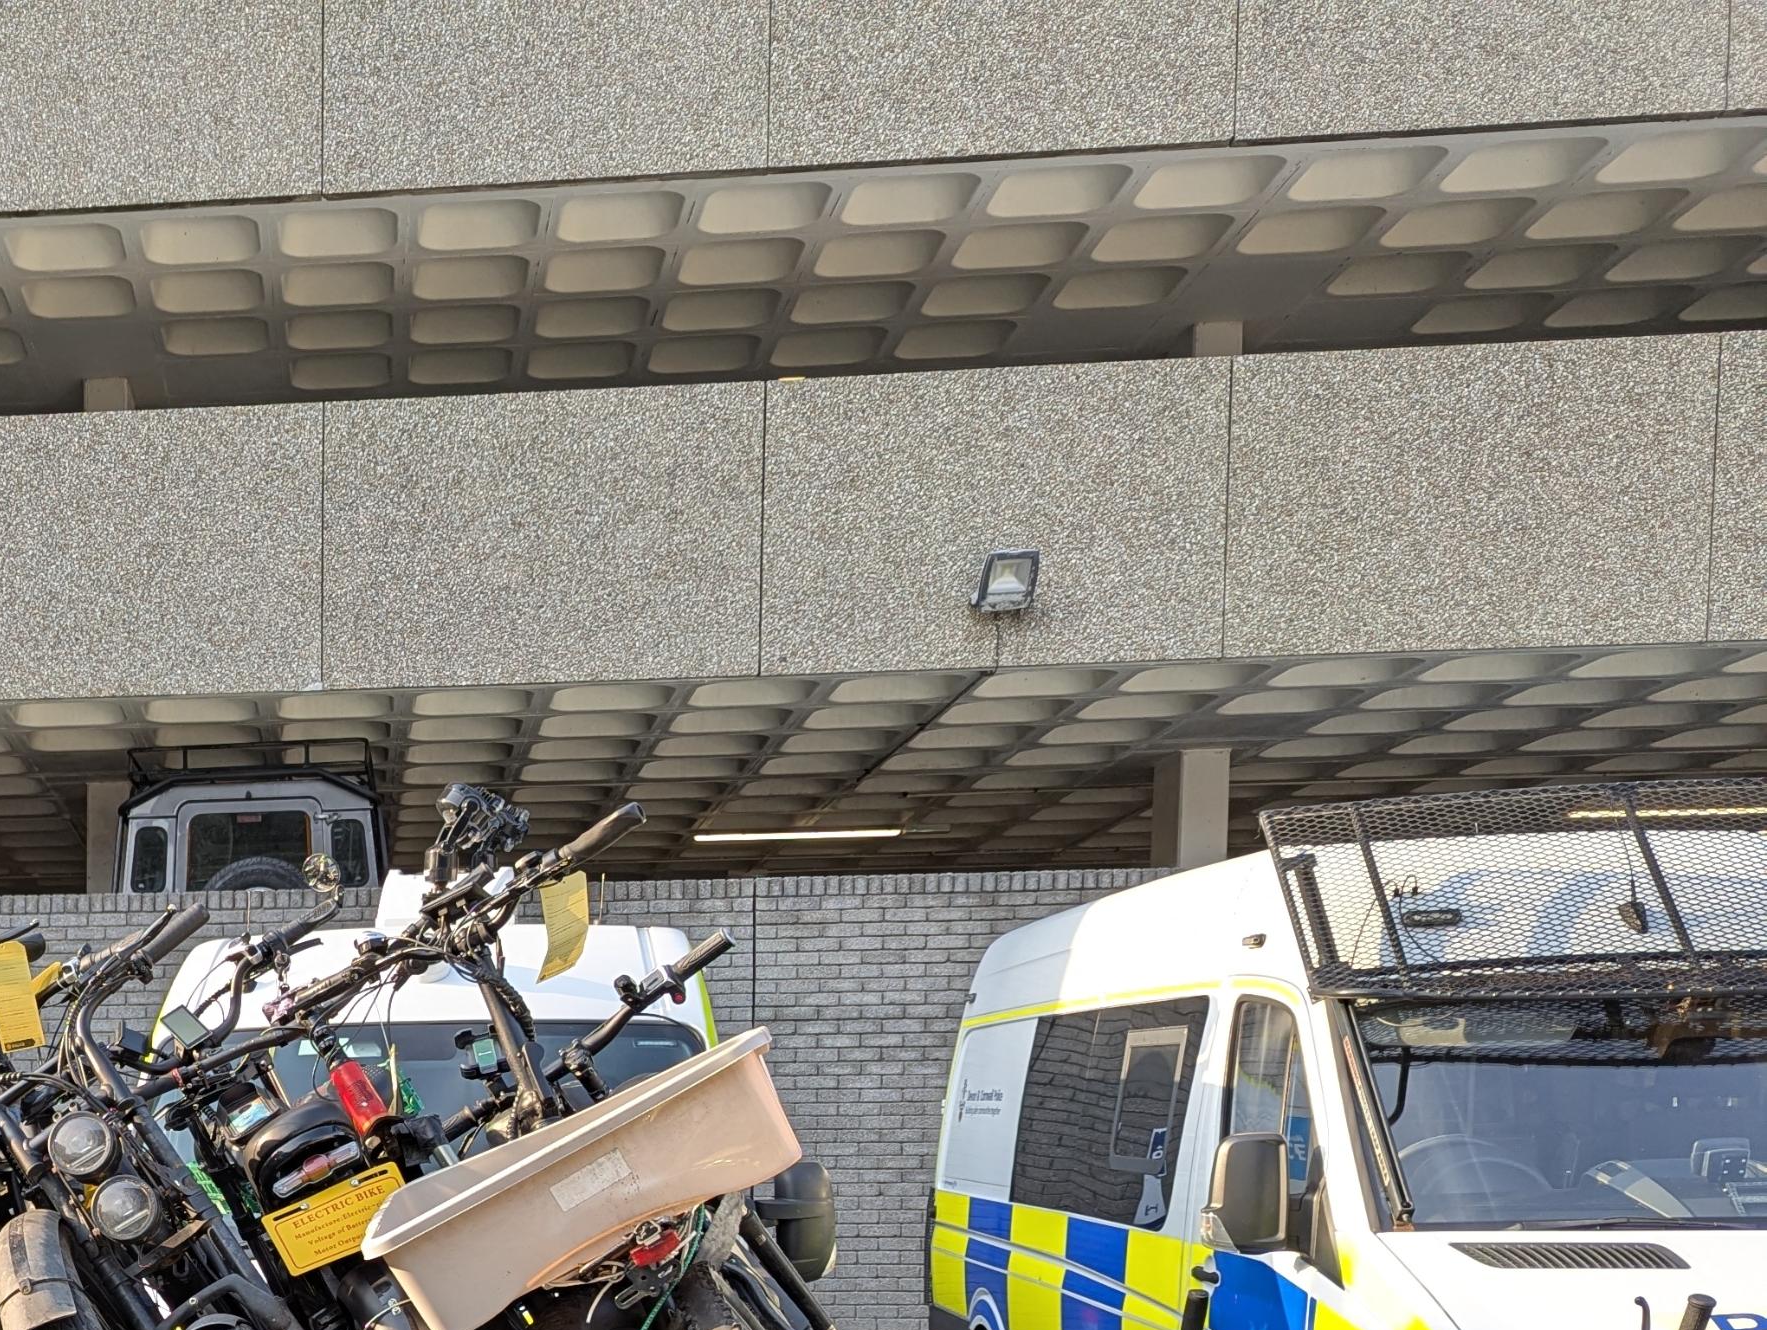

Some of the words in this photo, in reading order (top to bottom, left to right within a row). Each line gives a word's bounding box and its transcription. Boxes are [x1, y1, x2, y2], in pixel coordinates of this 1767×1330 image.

[292, 1196, 354, 1229] ELECTRIC
[356, 1185, 386, 1202] BIKE
[314, 1243, 336, 1257] Motor
